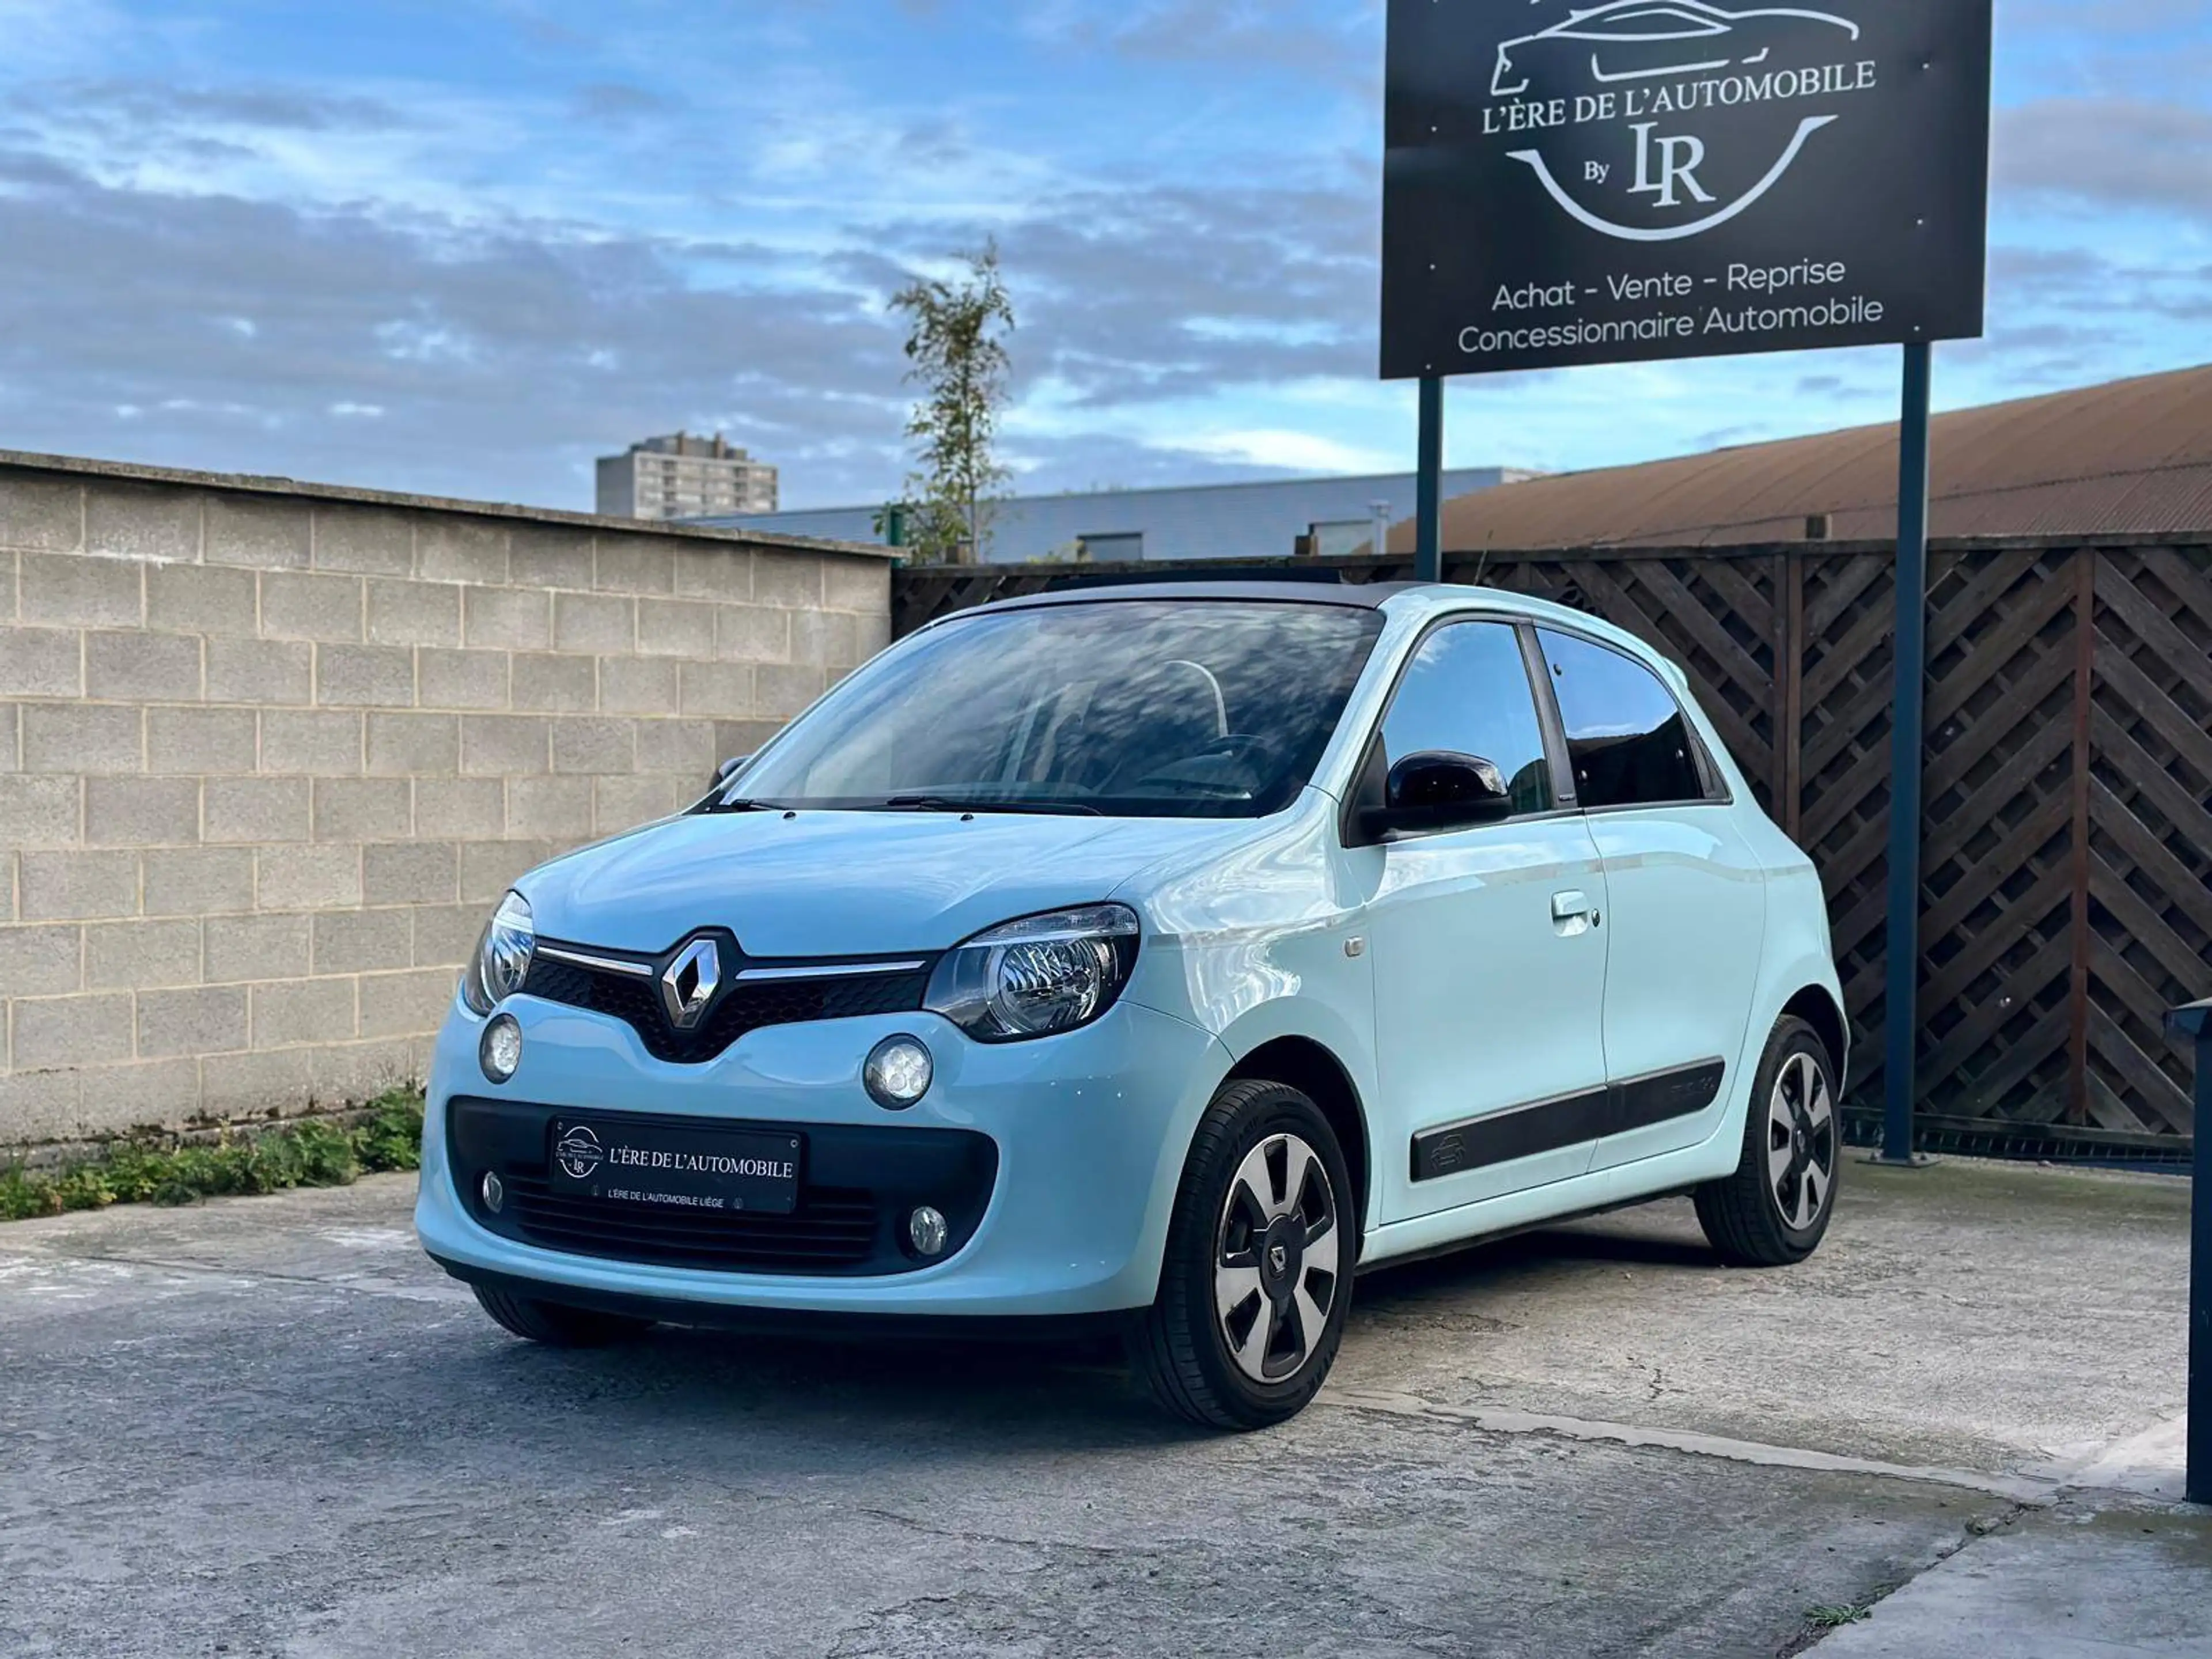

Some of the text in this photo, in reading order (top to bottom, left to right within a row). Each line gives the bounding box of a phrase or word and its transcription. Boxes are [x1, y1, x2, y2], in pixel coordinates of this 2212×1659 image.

[1482, 60, 1877, 134] L'ÈRE DE L'AUTOMOBILE
[1584, 121, 1717, 207] By LR
[1491, 281, 1575, 311] Achat
[1607, 272, 1692, 301] Vente
[1728, 257, 1846, 294] Reprise
[1459, 296, 1884, 353] Concessionnaire Automobile
[609, 1145, 793, 1178] L'ÈRE DE L'AUTOMOBILE
[630, 1191, 641, 1201] DE
[642, 1192, 699, 1206] L'AUTOMOBILE
